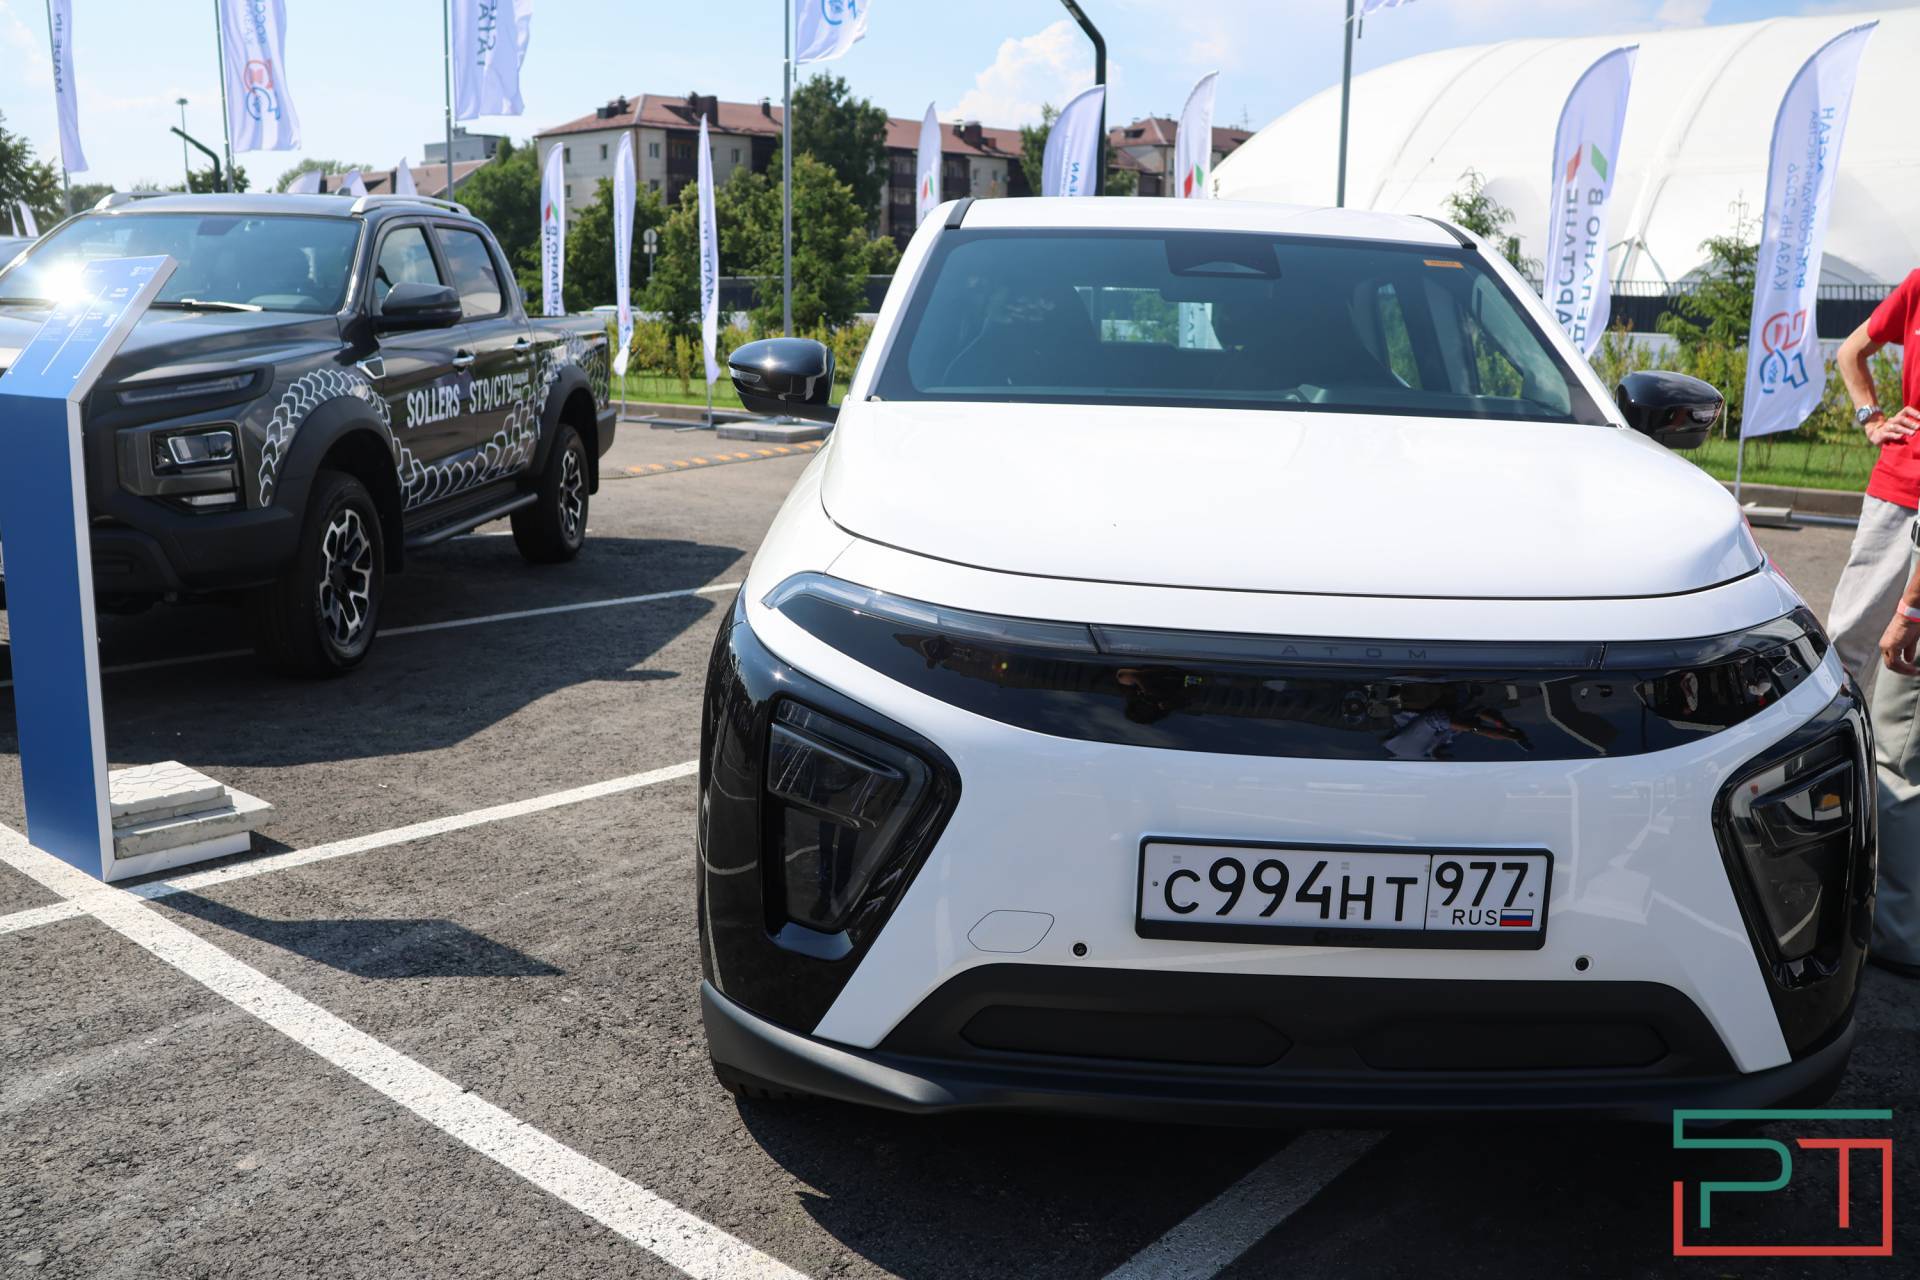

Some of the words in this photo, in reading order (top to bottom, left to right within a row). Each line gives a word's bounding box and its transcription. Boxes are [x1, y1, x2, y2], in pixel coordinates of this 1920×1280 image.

[407, 384, 460, 429] SOLLERS
[1281, 644, 1429, 660] ATOM
[1434, 860, 1530, 908] 977
[1451, 908, 1498, 927] RUS
